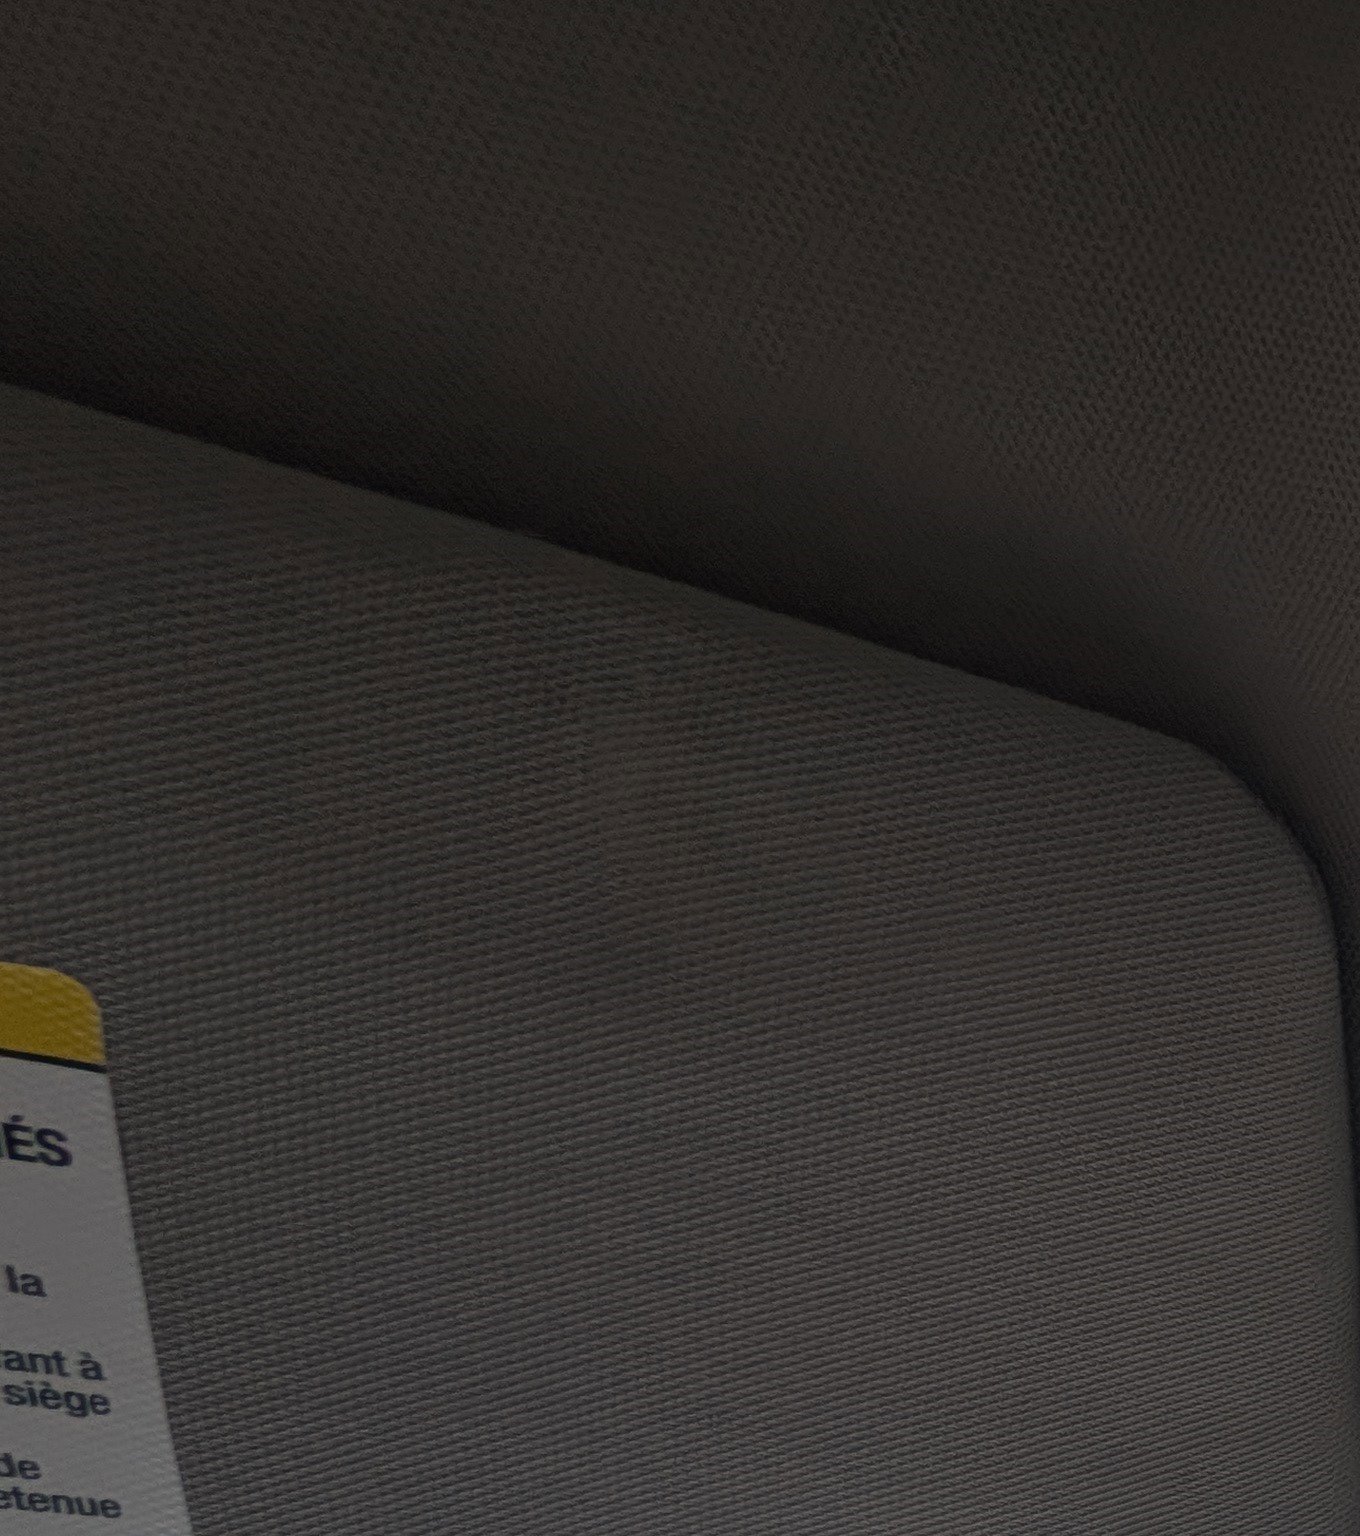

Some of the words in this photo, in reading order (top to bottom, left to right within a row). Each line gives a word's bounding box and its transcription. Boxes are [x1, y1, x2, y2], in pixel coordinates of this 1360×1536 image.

[0, 1114, 72, 1167] ÉS
[5, 1264, 48, 1297] la
[80, 1351, 107, 1381] à
[2, 1380, 112, 1418] siège
